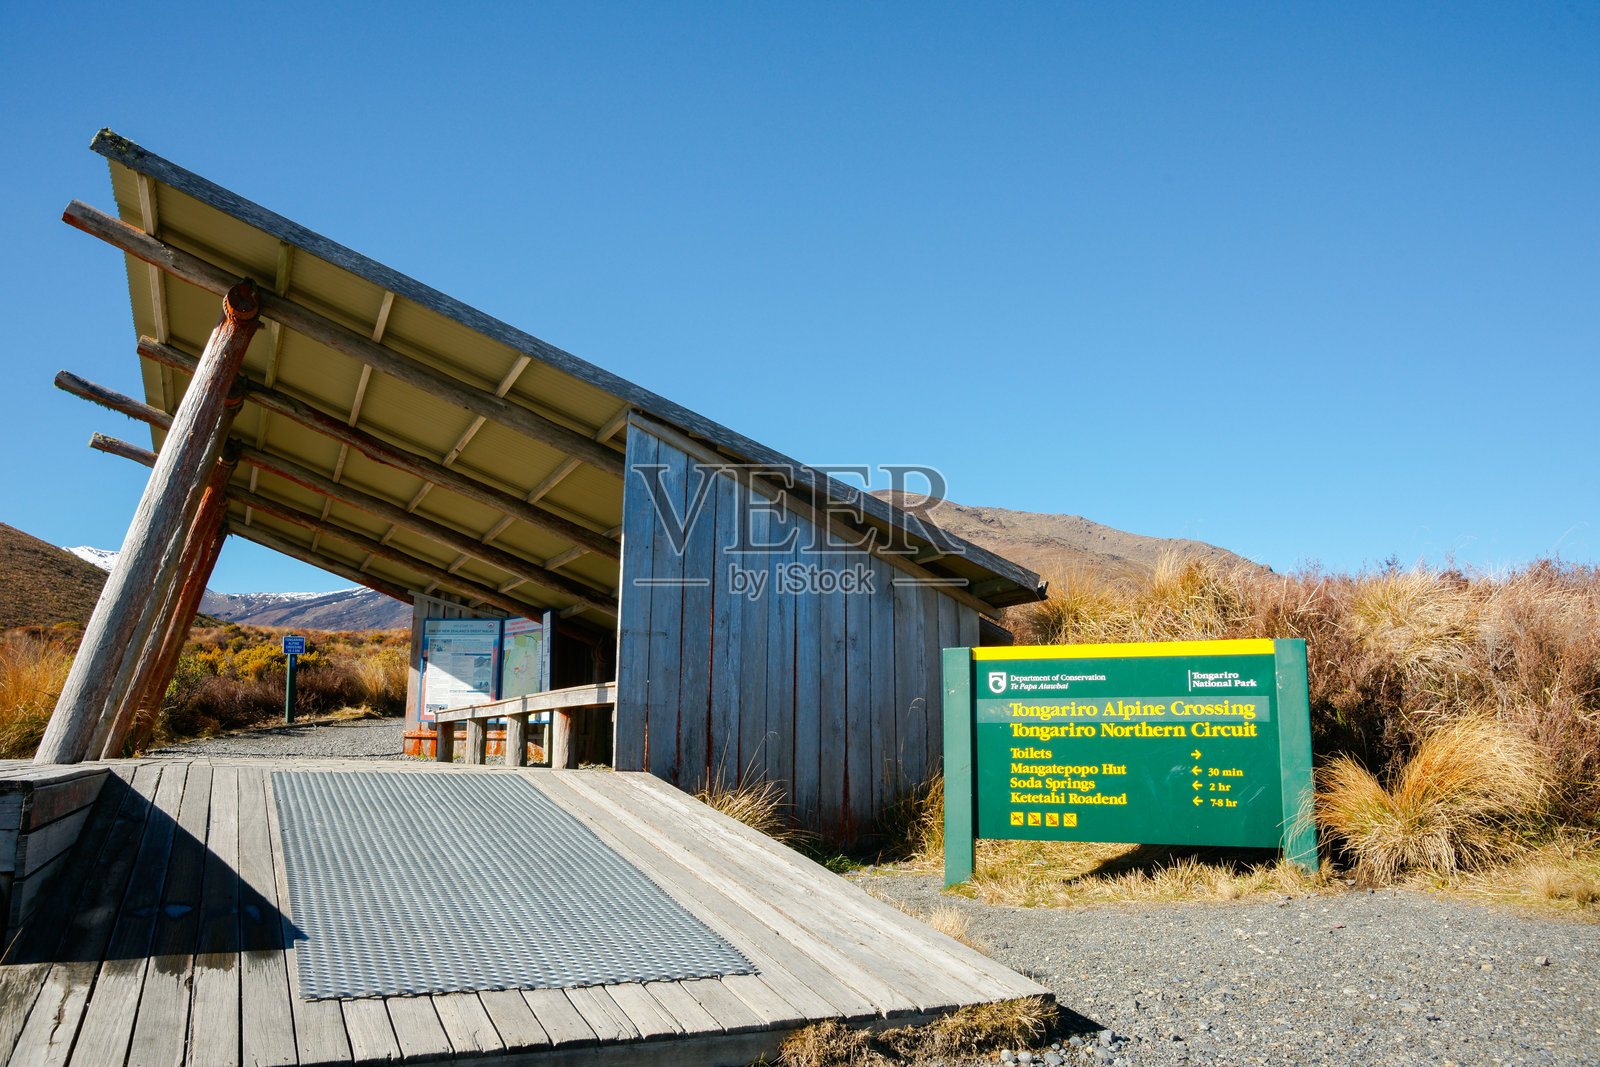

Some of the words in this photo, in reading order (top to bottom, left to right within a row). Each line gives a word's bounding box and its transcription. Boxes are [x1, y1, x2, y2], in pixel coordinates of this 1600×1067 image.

[1010, 675, 1050, 683] Department
[1192, 671, 1239, 680] Tongariro
[1019, 683, 1037, 691] Papa
[1192, 679, 1232, 687] National
[1234, 679, 1257, 687] Park
[1010, 702, 1098, 721] Tongariro
[1102, 701, 1166, 720] Alpine
[1170, 700, 1256, 719] Crossing
[1010, 723, 1096, 741] Tongariro
[1100, 722, 1186, 737] Northern
[1191, 722, 1258, 737] Circuit
[1010, 747, 1053, 759] Toilets
[1010, 763, 1099, 777] Mangatepopo
[1101, 763, 1127, 775] Hut
[1208, 767, 1220, 777] 30
[1222, 767, 1244, 777] min
[1010, 776, 1043, 788] Soda
[1045, 777, 1096, 792] Springs
[1209, 782, 1216, 791] 2
[1218, 782, 1232, 792] hr
[1010, 791, 1066, 804] Ketetahi
[1068, 793, 1128, 805] Roadend
[1210, 798, 1224, 807] 7-8
[1225, 798, 1238, 807] hr
